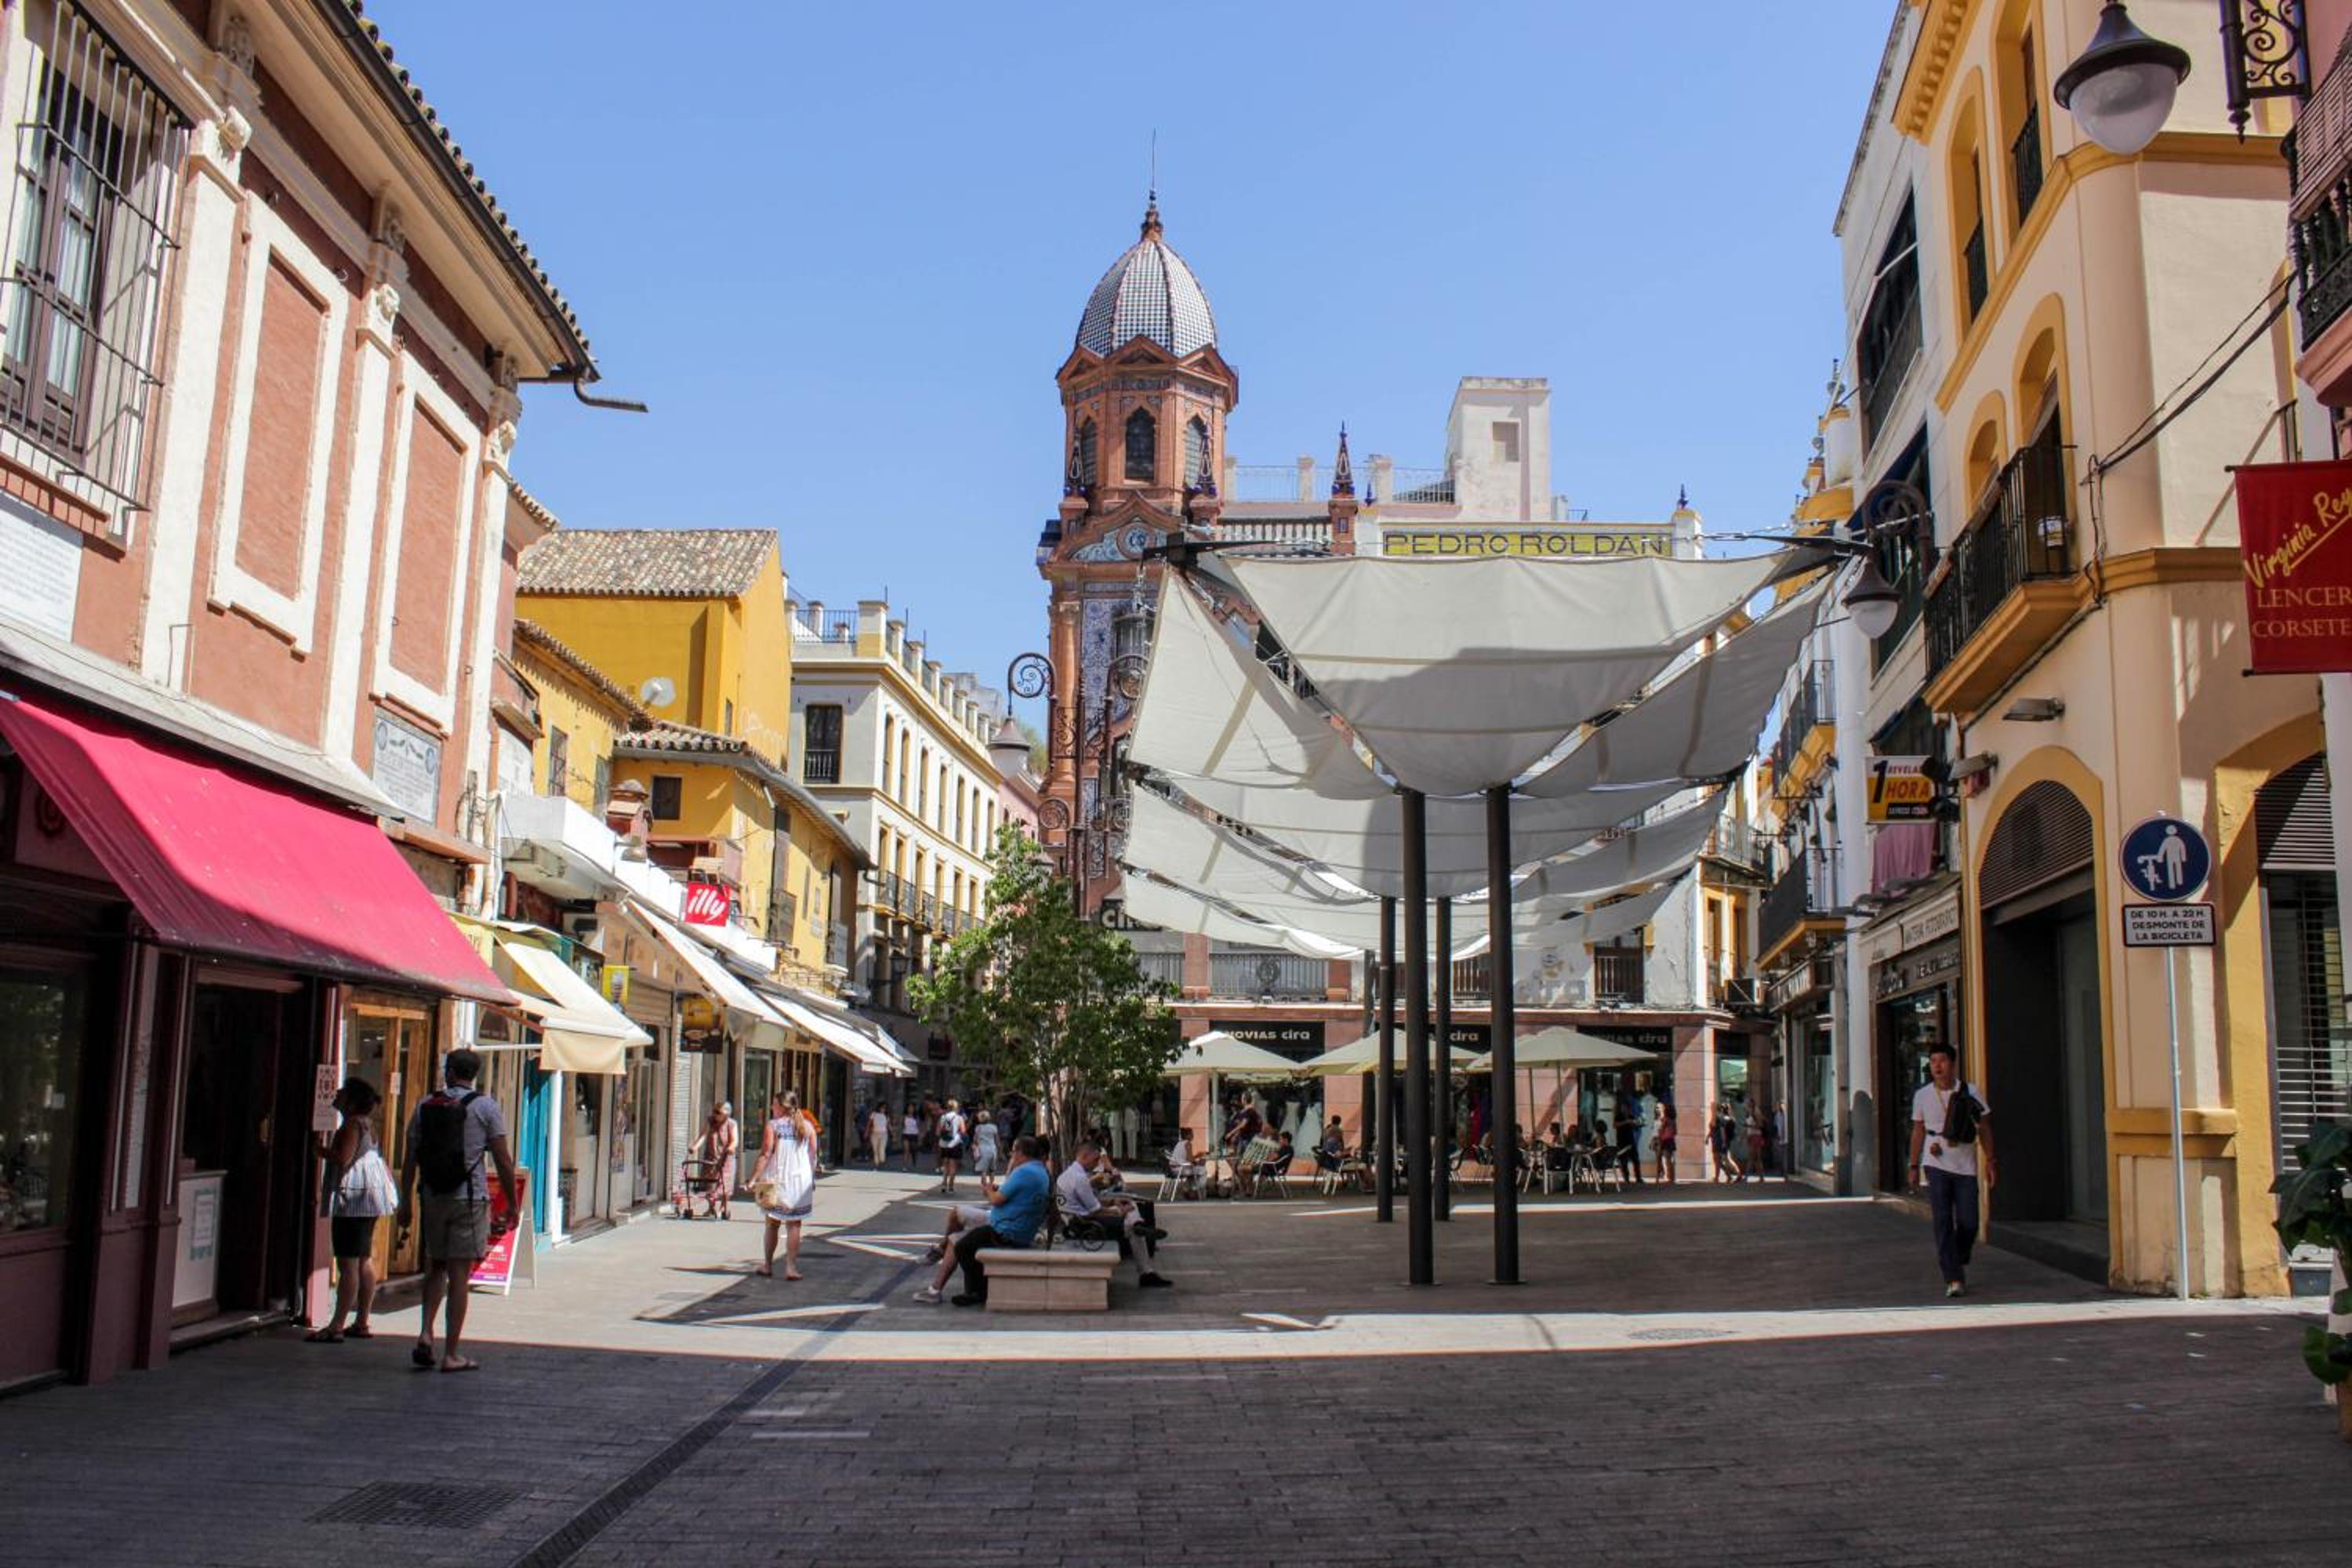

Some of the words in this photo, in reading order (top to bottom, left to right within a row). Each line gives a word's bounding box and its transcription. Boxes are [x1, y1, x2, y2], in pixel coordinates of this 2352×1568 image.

[1385, 534, 1508, 554] PEDRO
[2245, 521, 2317, 588] Virginia
[1888, 764, 1921, 775] REVELA
[1873, 760, 1889, 804] 1
[1885, 780, 1929, 799] HORA
[688, 888, 726, 922] illy
[2132, 921, 2190, 930] DESMONTE
[2191, 920, 2205, 929] DE
[2151, 931, 2203, 940] BICICLETA
[1282, 1029, 1311, 1040] cira
[1449, 1029, 1479, 1042] cira
